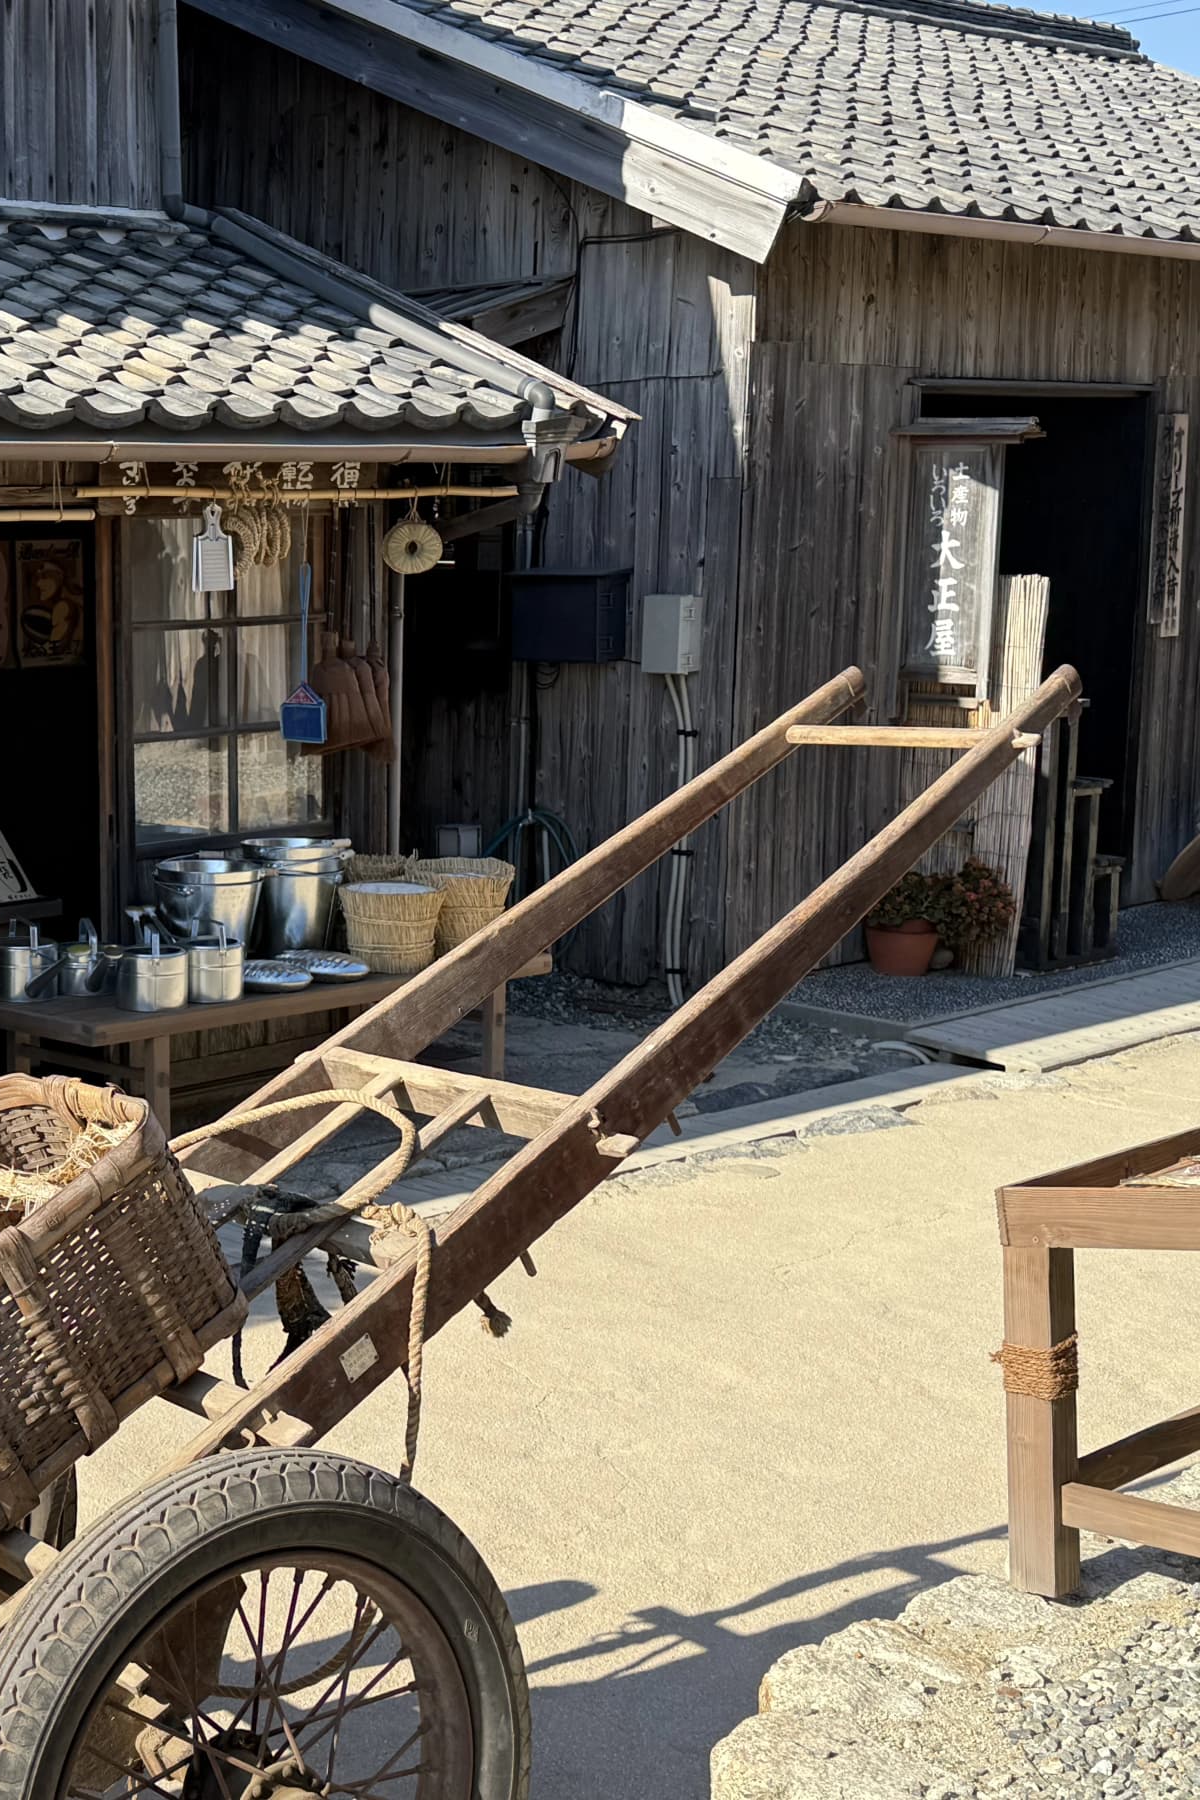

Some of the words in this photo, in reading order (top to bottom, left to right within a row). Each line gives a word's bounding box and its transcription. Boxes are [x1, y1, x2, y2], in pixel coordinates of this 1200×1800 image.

[929, 464, 947, 527] いろいろ
[951, 462, 970, 527] 土産物
[924, 530, 966, 657] 大正屋
